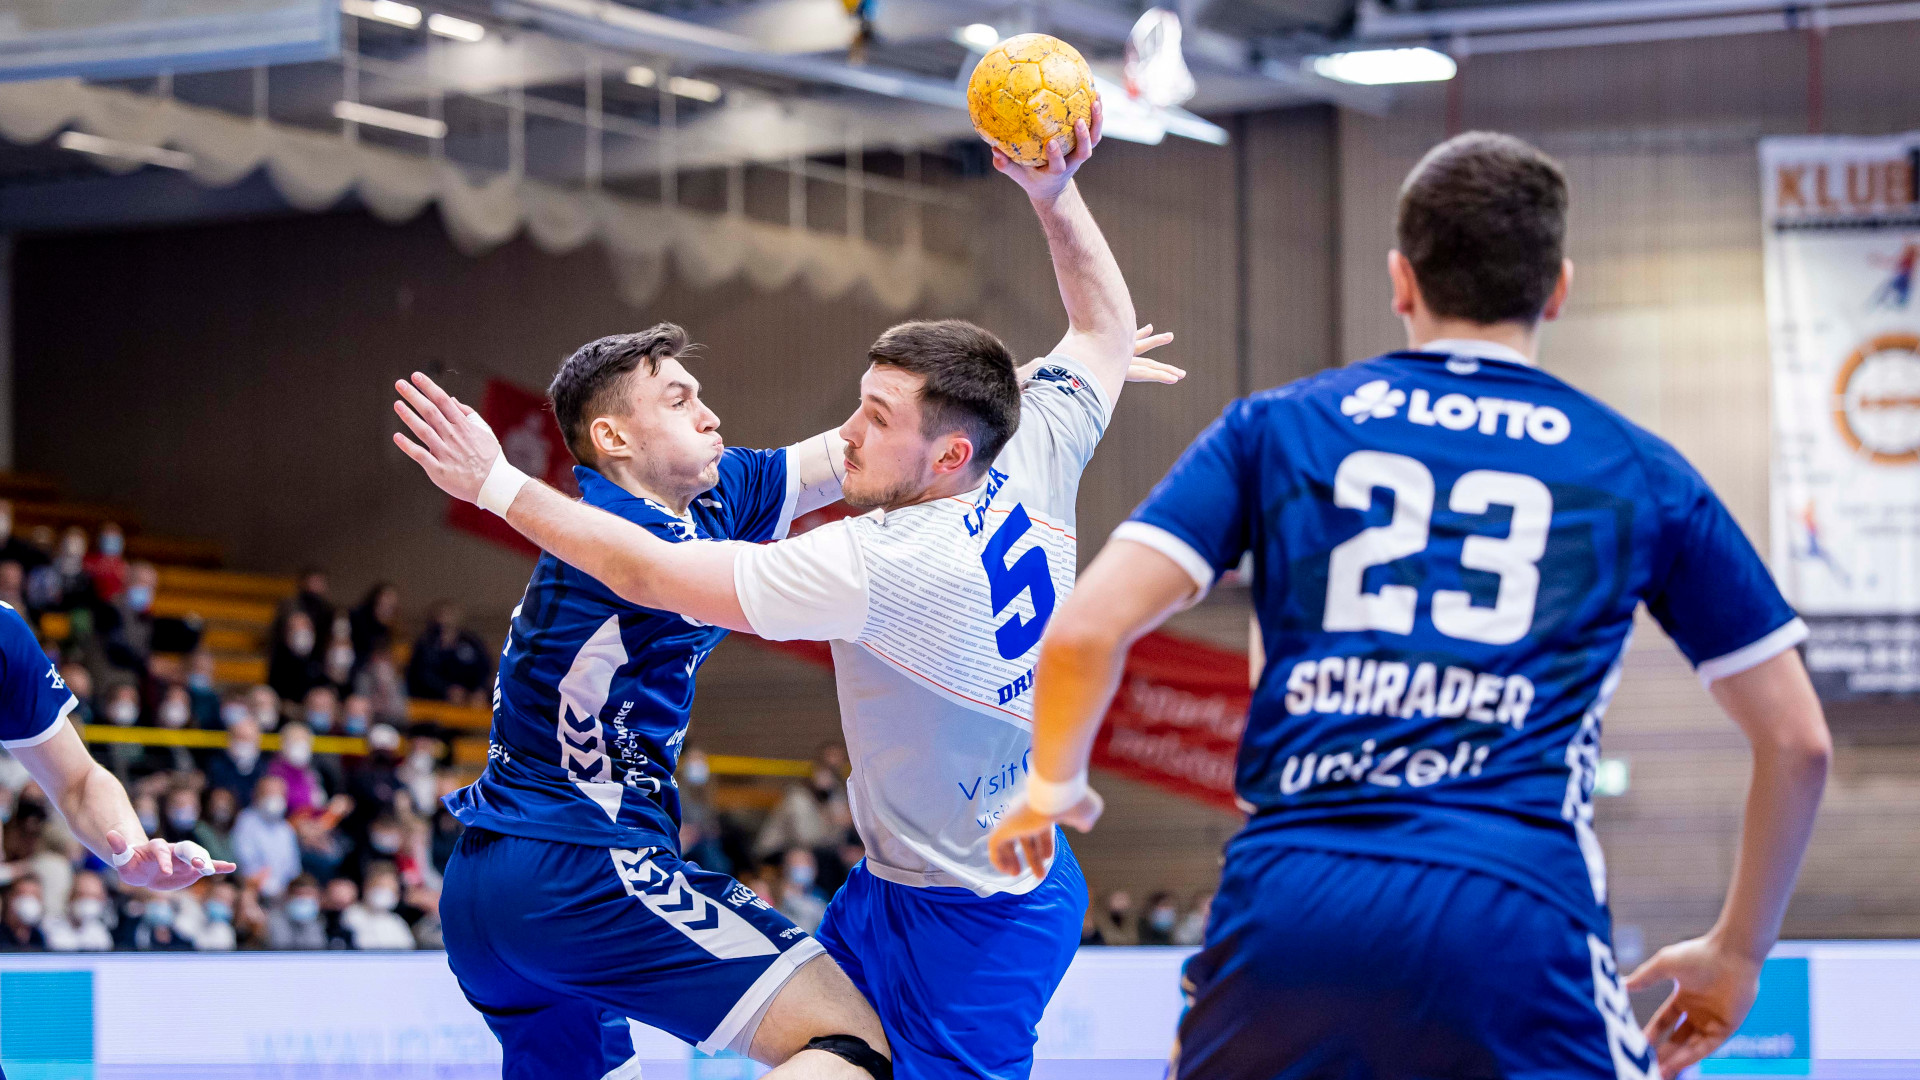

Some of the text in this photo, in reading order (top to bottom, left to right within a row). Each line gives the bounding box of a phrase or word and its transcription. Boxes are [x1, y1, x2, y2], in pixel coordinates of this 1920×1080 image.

[1407, 388, 1571, 445] LOTTO
[981, 502, 1056, 660] 5
[1322, 449, 1554, 645] 23
[1284, 656, 1535, 730] SCHRADER
[958, 762, 1018, 801] Visit
